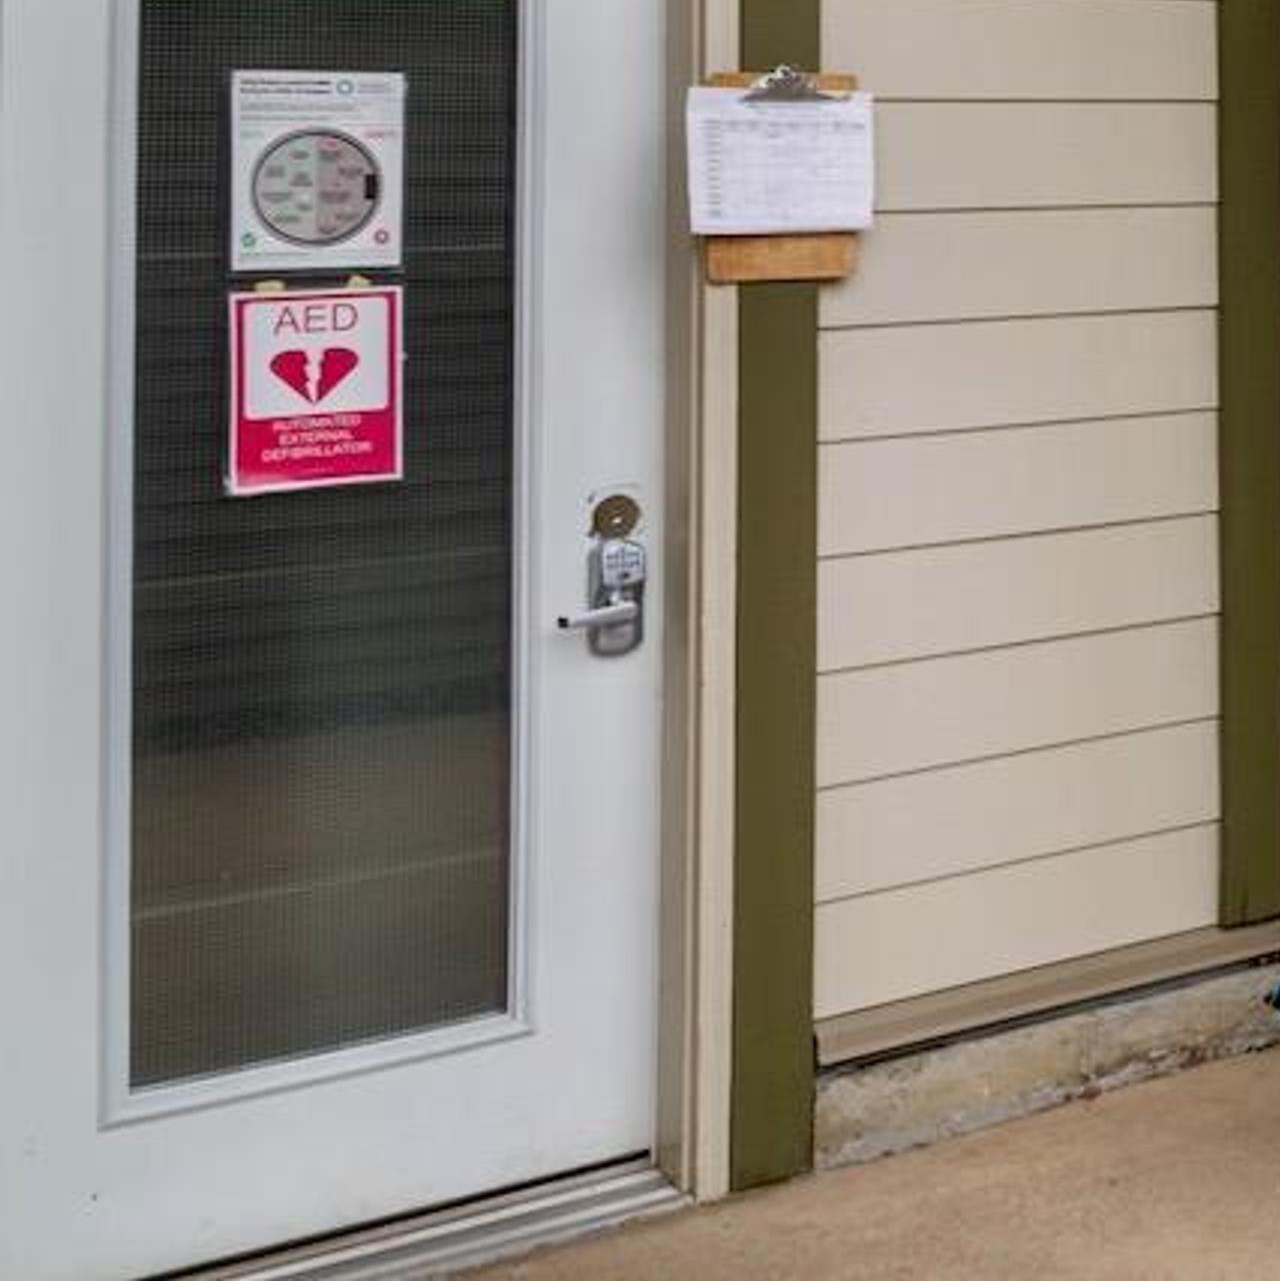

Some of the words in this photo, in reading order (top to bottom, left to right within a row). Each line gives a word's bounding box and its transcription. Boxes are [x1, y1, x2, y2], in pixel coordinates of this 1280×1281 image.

[273, 303, 359, 336] AED
[272, 414, 362, 432] AUTOMATED
[278, 430, 354, 446] EXTERNAL
[261, 441, 372, 462] DEFIBRILLATOR
